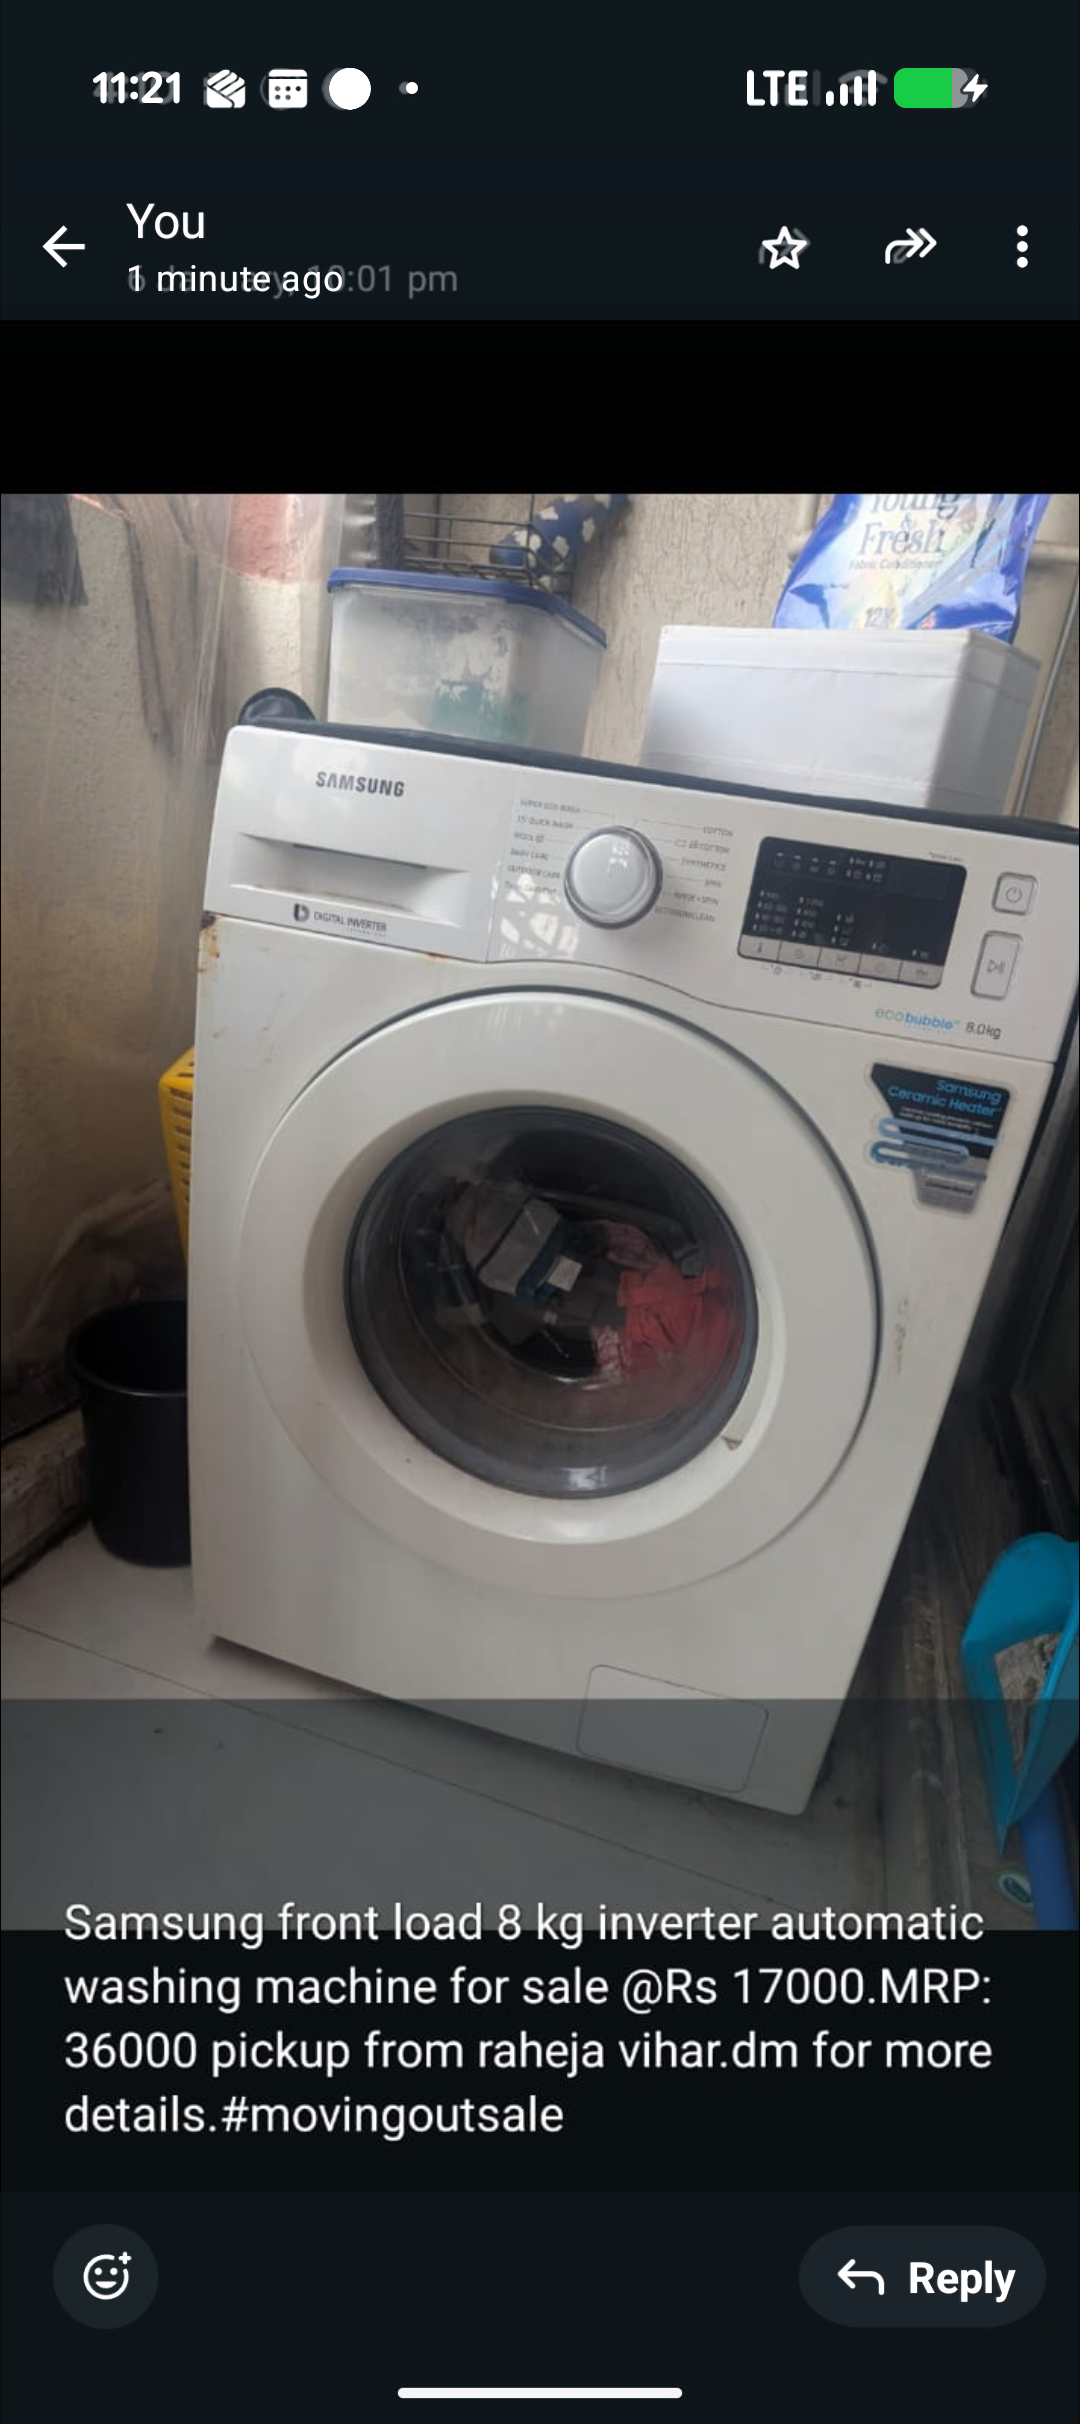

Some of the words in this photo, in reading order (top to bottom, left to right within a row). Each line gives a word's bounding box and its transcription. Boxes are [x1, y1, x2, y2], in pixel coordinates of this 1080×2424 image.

[871, 494, 960, 520] Young
[858, 520, 946, 555] Fresh
[316, 771, 405, 797] SAMSUNG
[314, 911, 345, 925] DIGITAL
[347, 917, 387, 932] INVERTER
[887, 1085, 947, 1107] Ceramic
[949, 1099, 998, 1118] Heater
[936, 1079, 1002, 1106] Samsung
